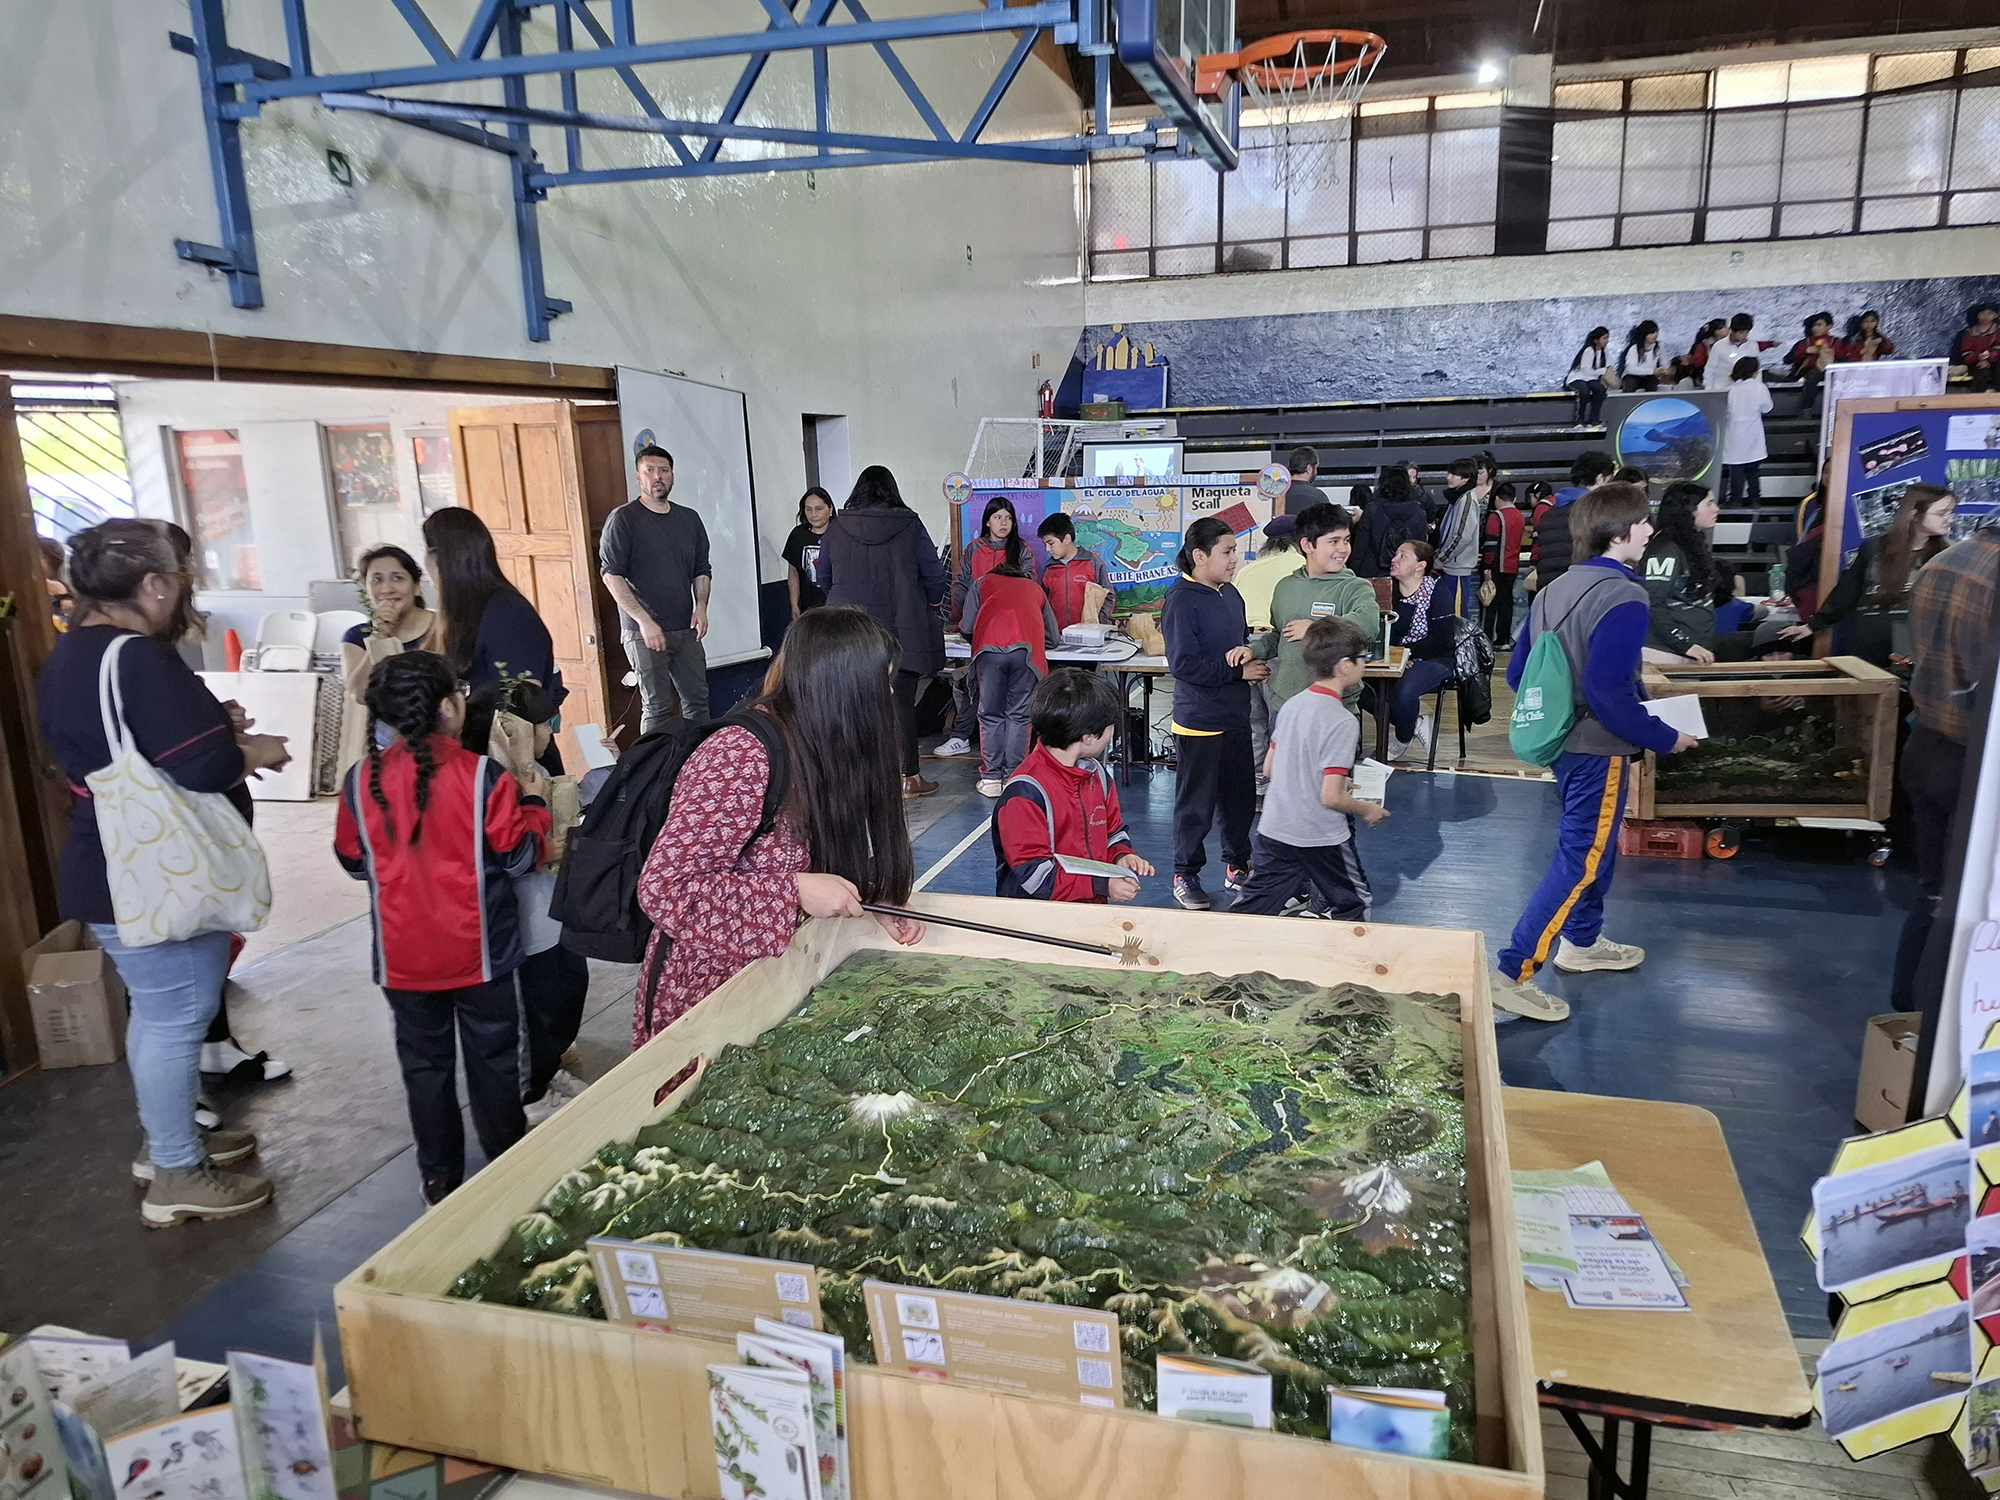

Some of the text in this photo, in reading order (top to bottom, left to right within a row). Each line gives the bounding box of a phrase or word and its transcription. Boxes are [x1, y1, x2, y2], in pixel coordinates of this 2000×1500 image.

[971, 478, 1003, 488] AGUA
[1006, 477, 1038, 488] PARA
[1075, 476, 1104, 487] VIDA
[1118, 475, 1134, 486] EN
[1098, 489, 1122, 497] CICLO
[1142, 488, 1166, 496] AGUA
[1191, 486, 1251, 500] Maqueta
[1191, 498, 1220, 511] Scall
